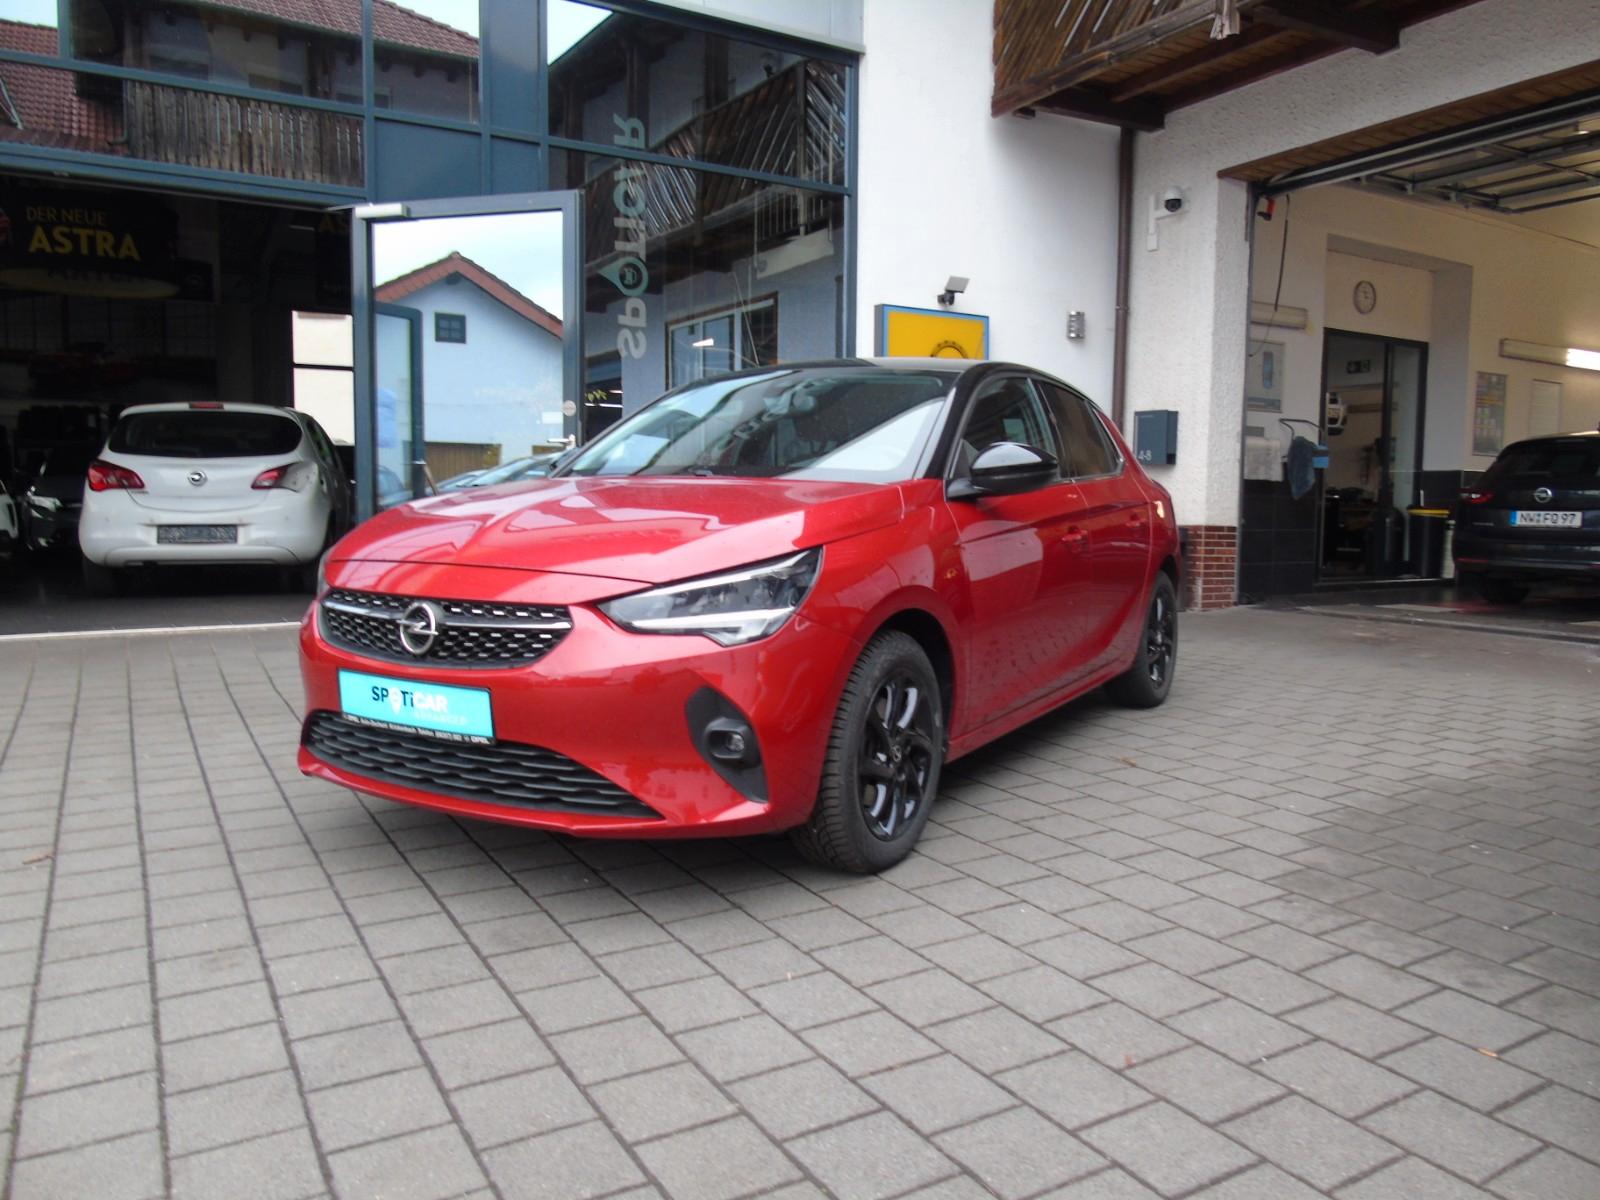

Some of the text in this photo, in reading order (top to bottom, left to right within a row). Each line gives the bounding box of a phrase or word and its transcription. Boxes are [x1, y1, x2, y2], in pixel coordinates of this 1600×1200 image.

[26, 206, 107, 226] DER NEUE
[28, 224, 141, 262] ASTRA
